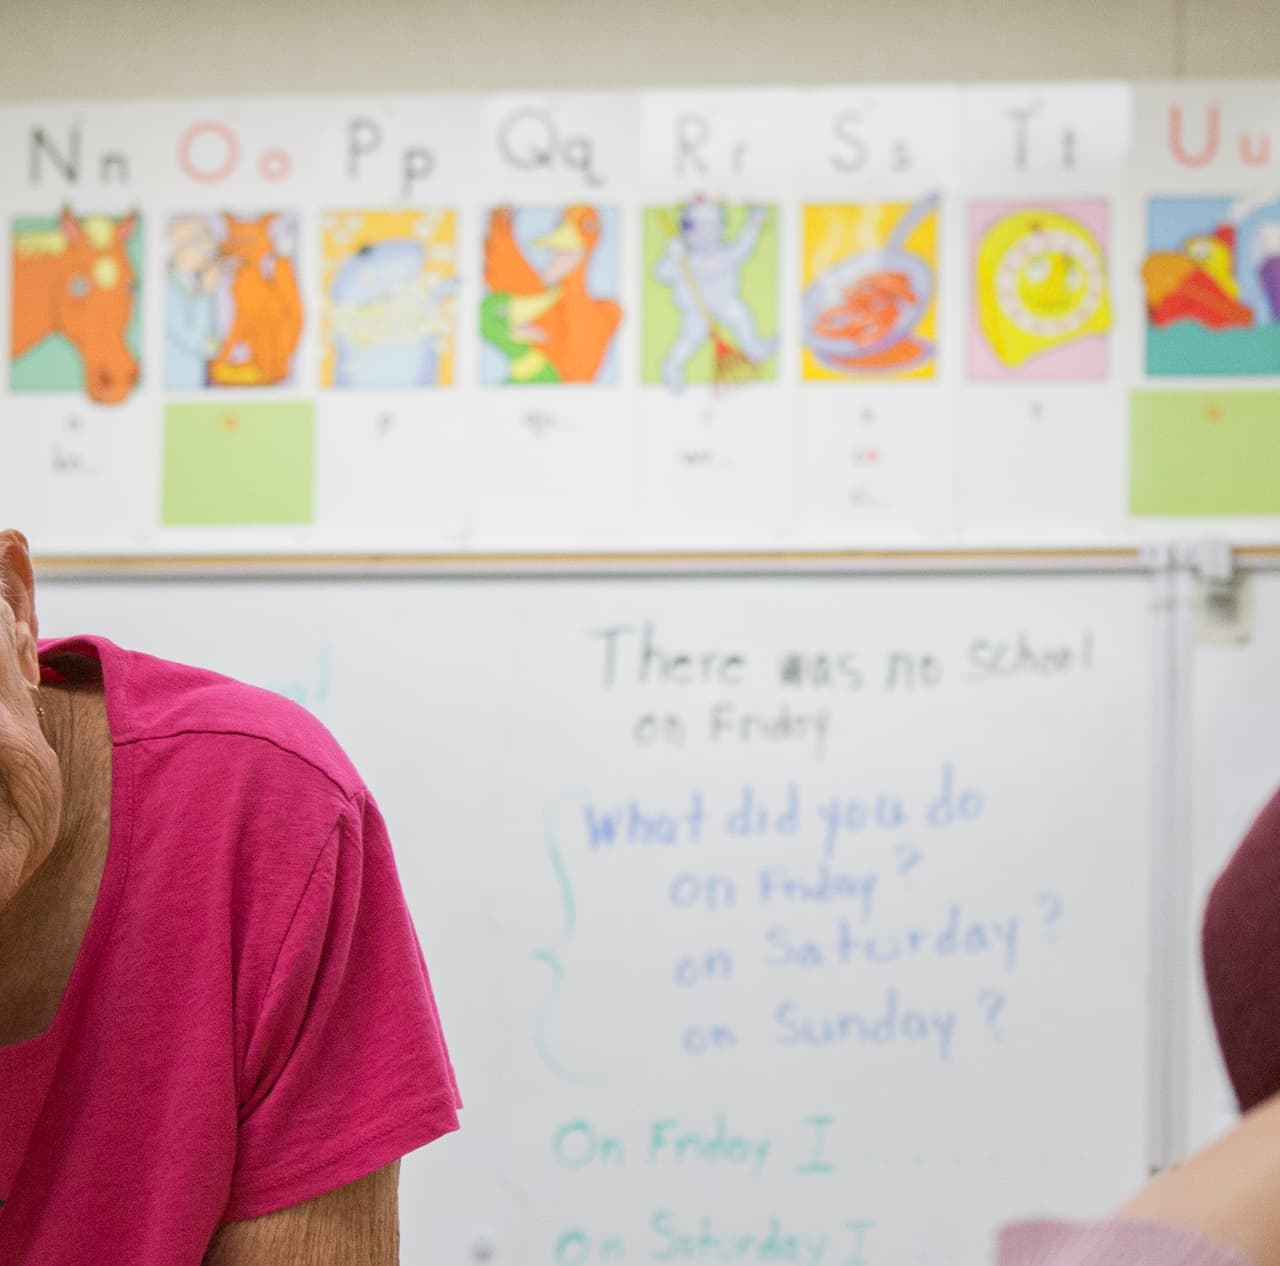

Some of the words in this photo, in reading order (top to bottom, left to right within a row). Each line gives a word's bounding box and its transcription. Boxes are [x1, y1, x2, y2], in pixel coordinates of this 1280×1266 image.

[583, 621, 747, 690] There
[778, 648, 866, 690] was
[884, 646, 942, 690] no
[632, 709, 685, 748] on
[709, 702, 830, 763] Friday
[583, 789, 708, 850] What
[726, 782, 801, 838] did
[818, 793, 908, 857] you
[926, 762, 986, 829] do
[668, 872, 737, 910] on
[674, 949, 733, 989] on
[681, 1022, 738, 1055] on
[551, 1118, 625, 1170] On
[646, 1112, 771, 1179] Friday
